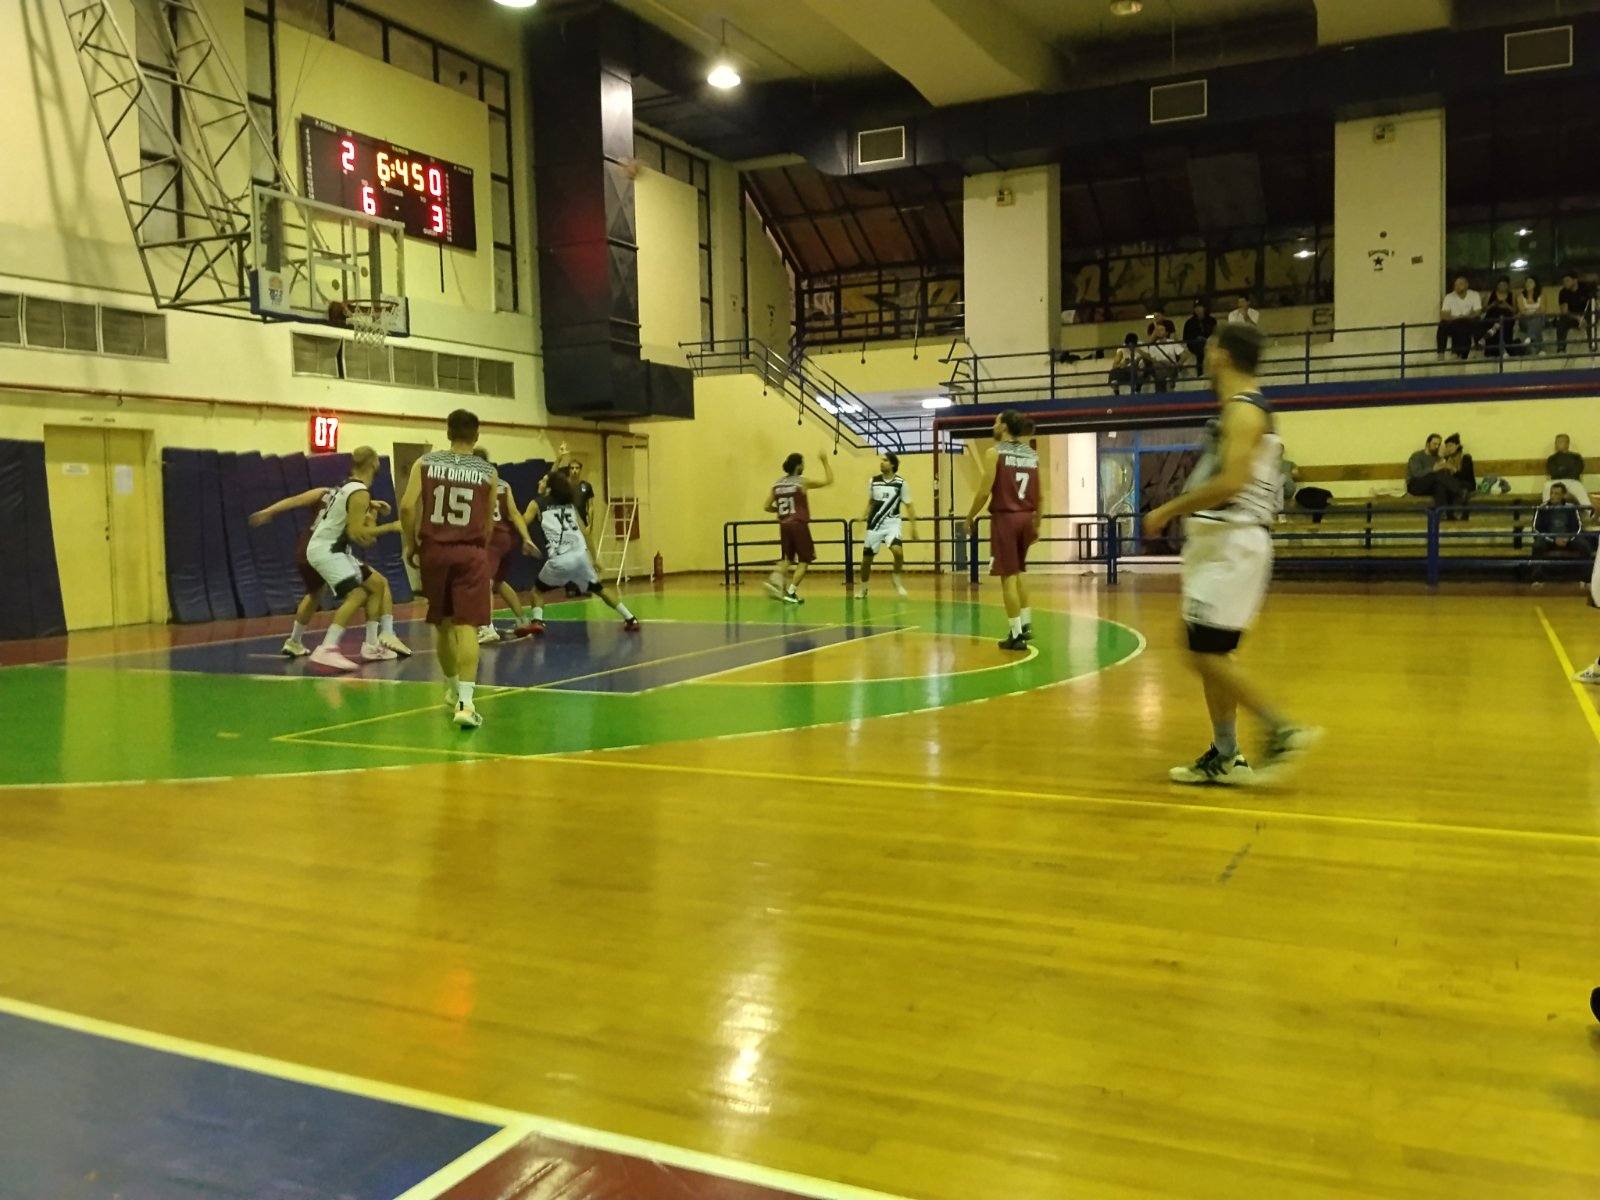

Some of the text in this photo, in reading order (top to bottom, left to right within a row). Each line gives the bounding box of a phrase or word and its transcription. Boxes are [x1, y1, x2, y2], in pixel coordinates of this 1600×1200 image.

[342, 140, 355, 171] 2
[377, 152, 425, 192] 6:45
[429, 168, 442, 196] 0
[362, 187, 376, 216] 6
[431, 204, 444, 233] 3
[315, 416, 339, 449] 07
[1015, 472, 1030, 500] 7
[430, 485, 474, 527] 15
[778, 497, 797, 515] 21
